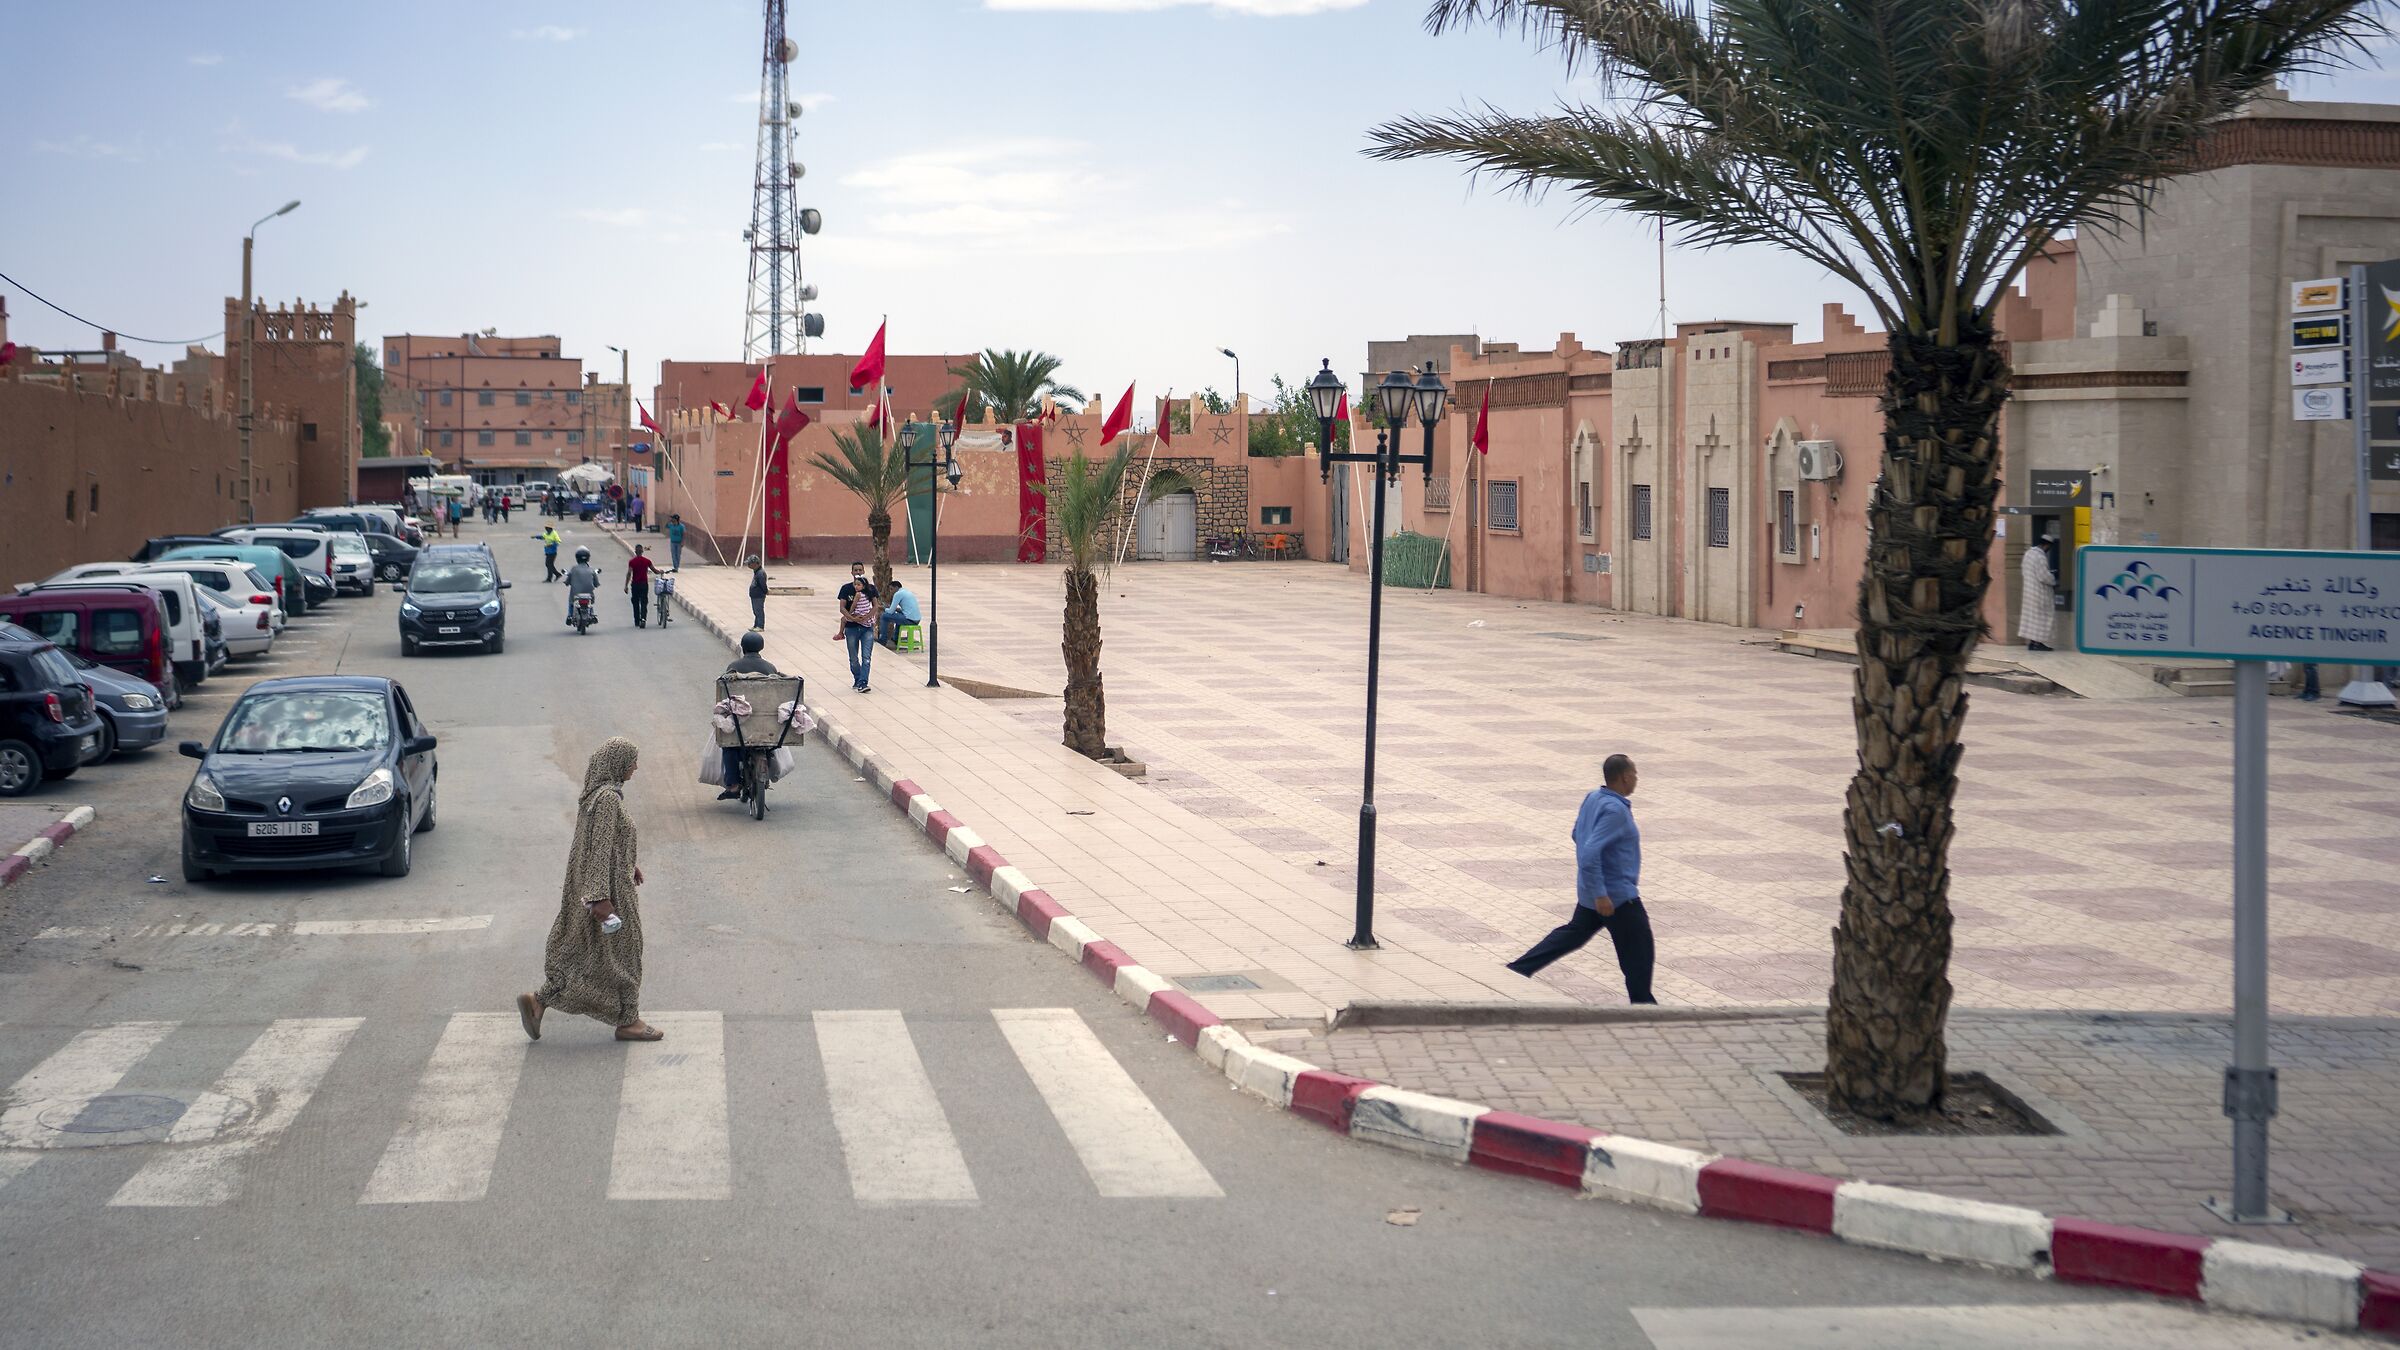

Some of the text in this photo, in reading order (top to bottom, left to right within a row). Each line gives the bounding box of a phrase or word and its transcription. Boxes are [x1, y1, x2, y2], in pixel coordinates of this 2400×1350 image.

[2258, 576, 2379, 599] وكالة تنغير
[2106, 631, 2169, 642] CNSS
[2249, 624, 2388, 643] AGENCE TINGHIR
[256, 824, 278, 835] 6205
[301, 823, 313, 834] 86
